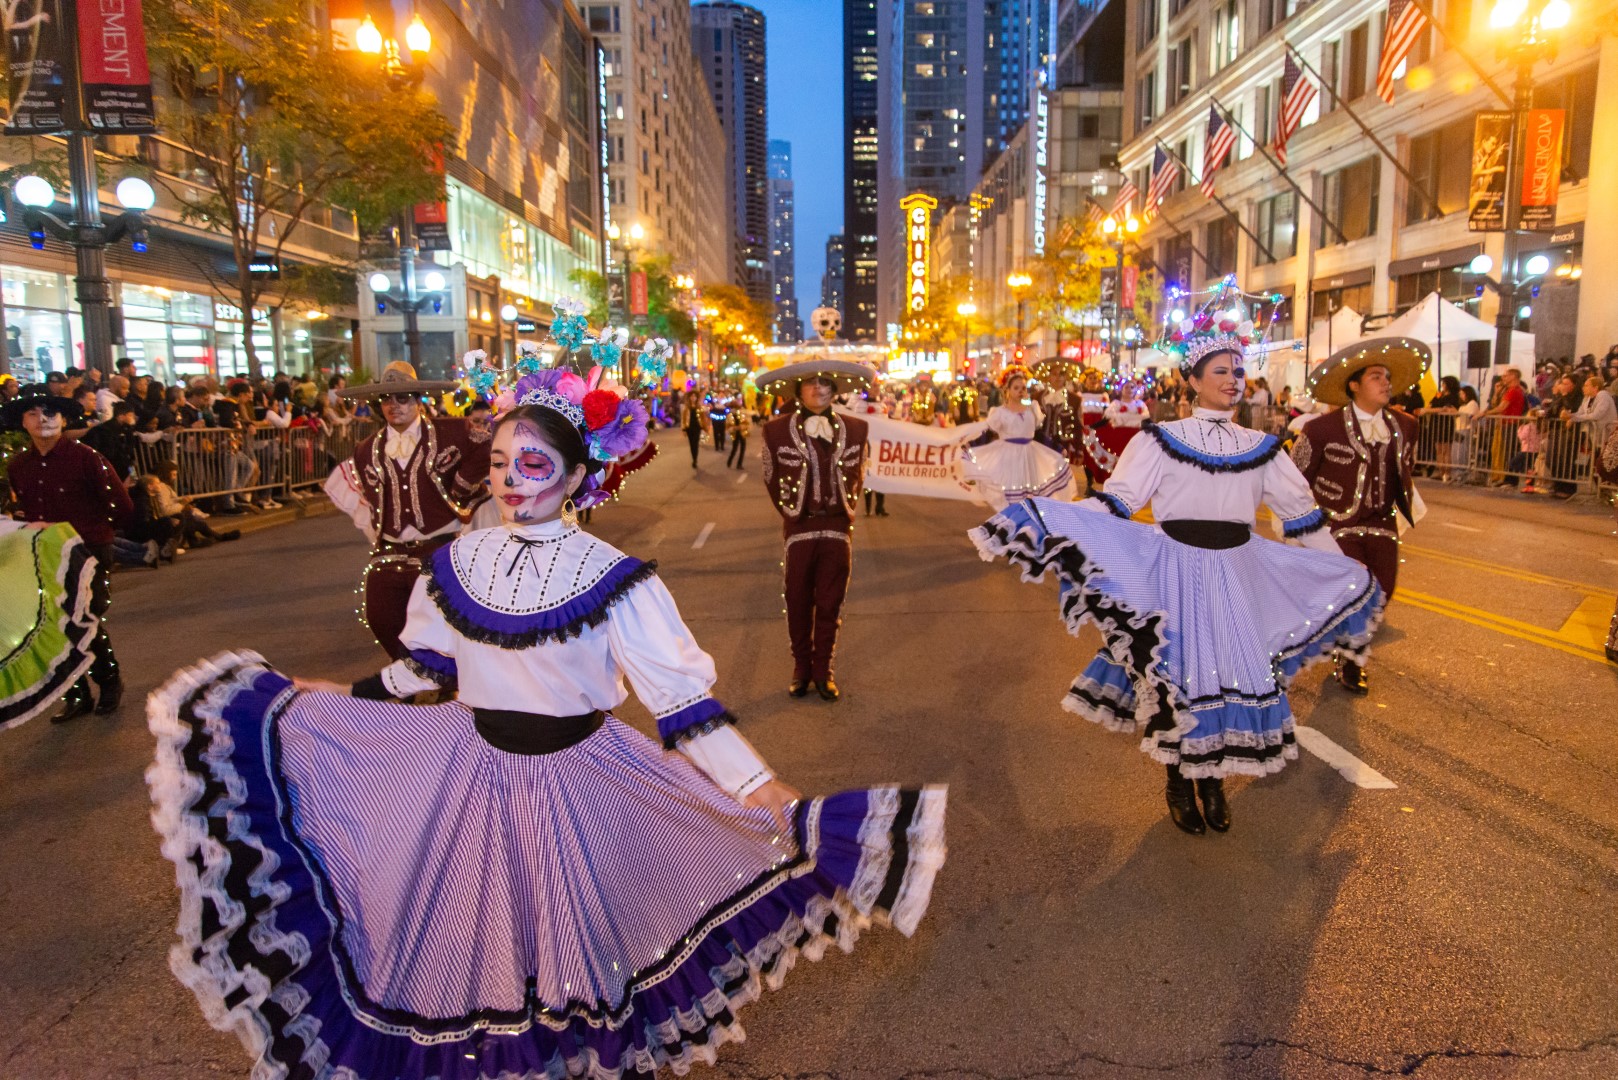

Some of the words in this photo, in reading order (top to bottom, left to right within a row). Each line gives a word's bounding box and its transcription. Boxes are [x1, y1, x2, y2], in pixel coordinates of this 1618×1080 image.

[1036, 90, 1048, 167] BALLET
[1531, 113, 1553, 202] ATONEMENT
[1033, 168, 1047, 258] JOFFREY
[911, 207, 926, 315] CHICAG
[878, 440, 950, 466] BALLET
